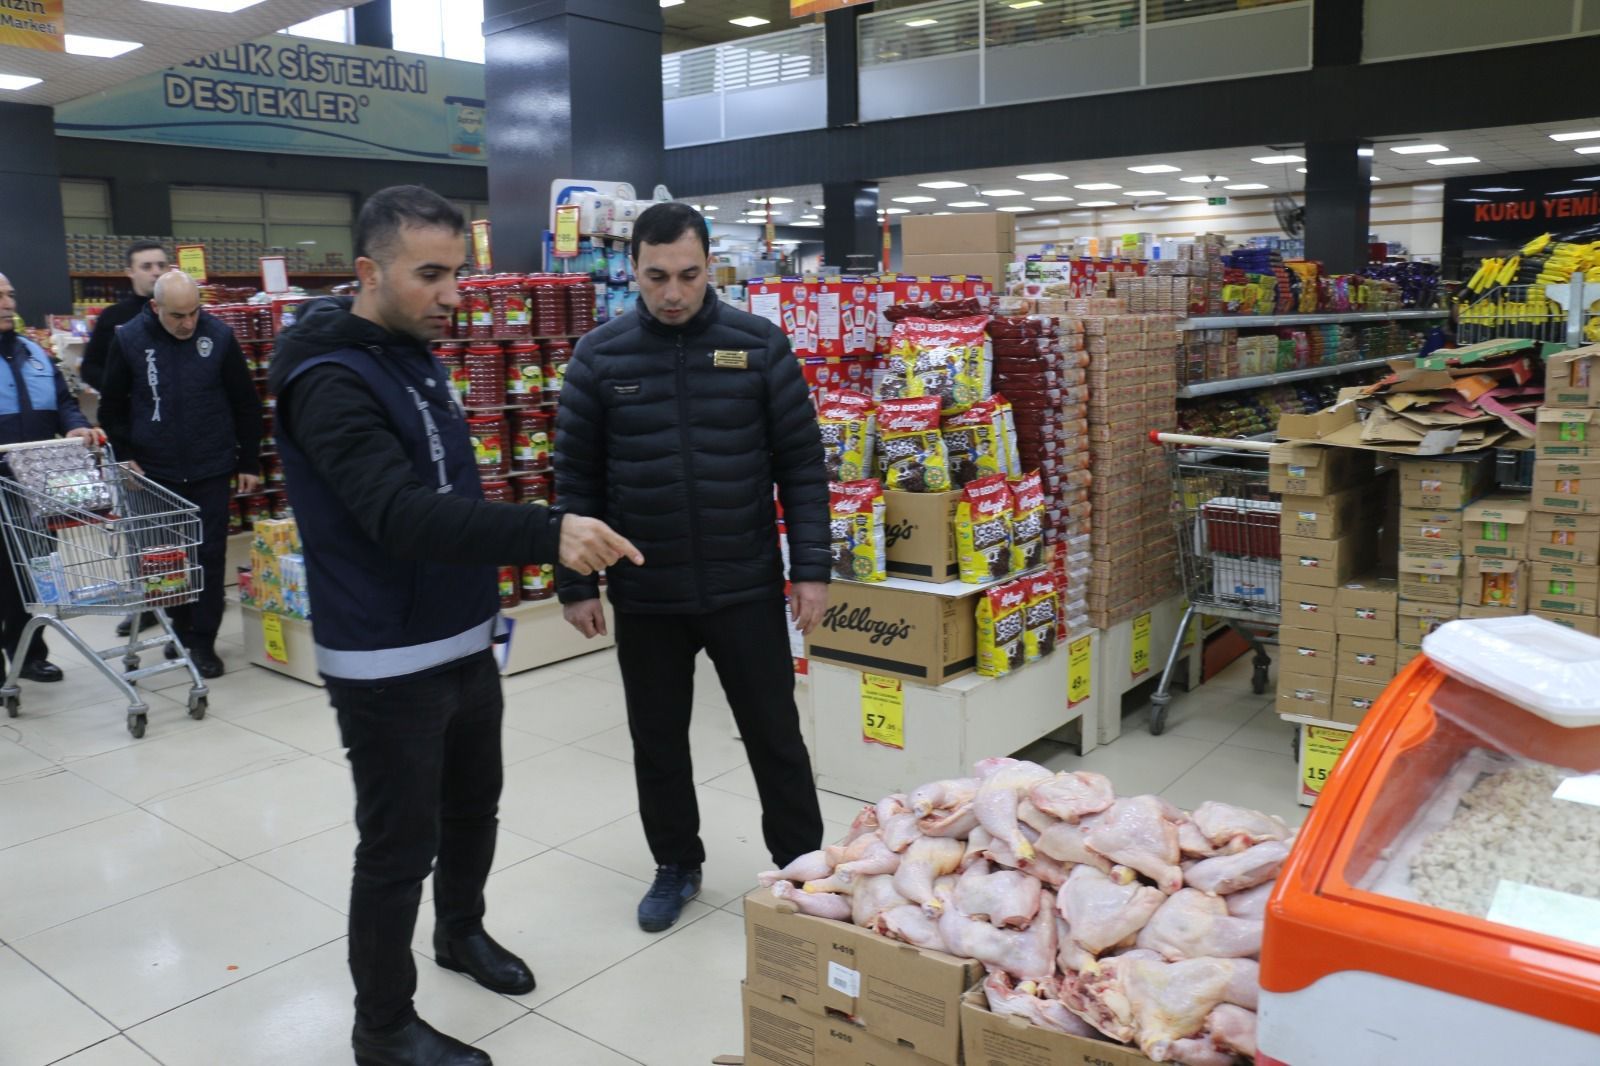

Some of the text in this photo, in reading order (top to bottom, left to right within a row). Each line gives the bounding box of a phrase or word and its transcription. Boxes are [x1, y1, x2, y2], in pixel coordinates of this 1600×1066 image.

[279, 45, 428, 93] SİSTEMİNİ
[1474, 192, 1600, 222] KURU YEMİ
[145, 349, 161, 422] ZABITA
[822, 602, 911, 646] Kellogg's
[866, 713, 886, 729] 57
